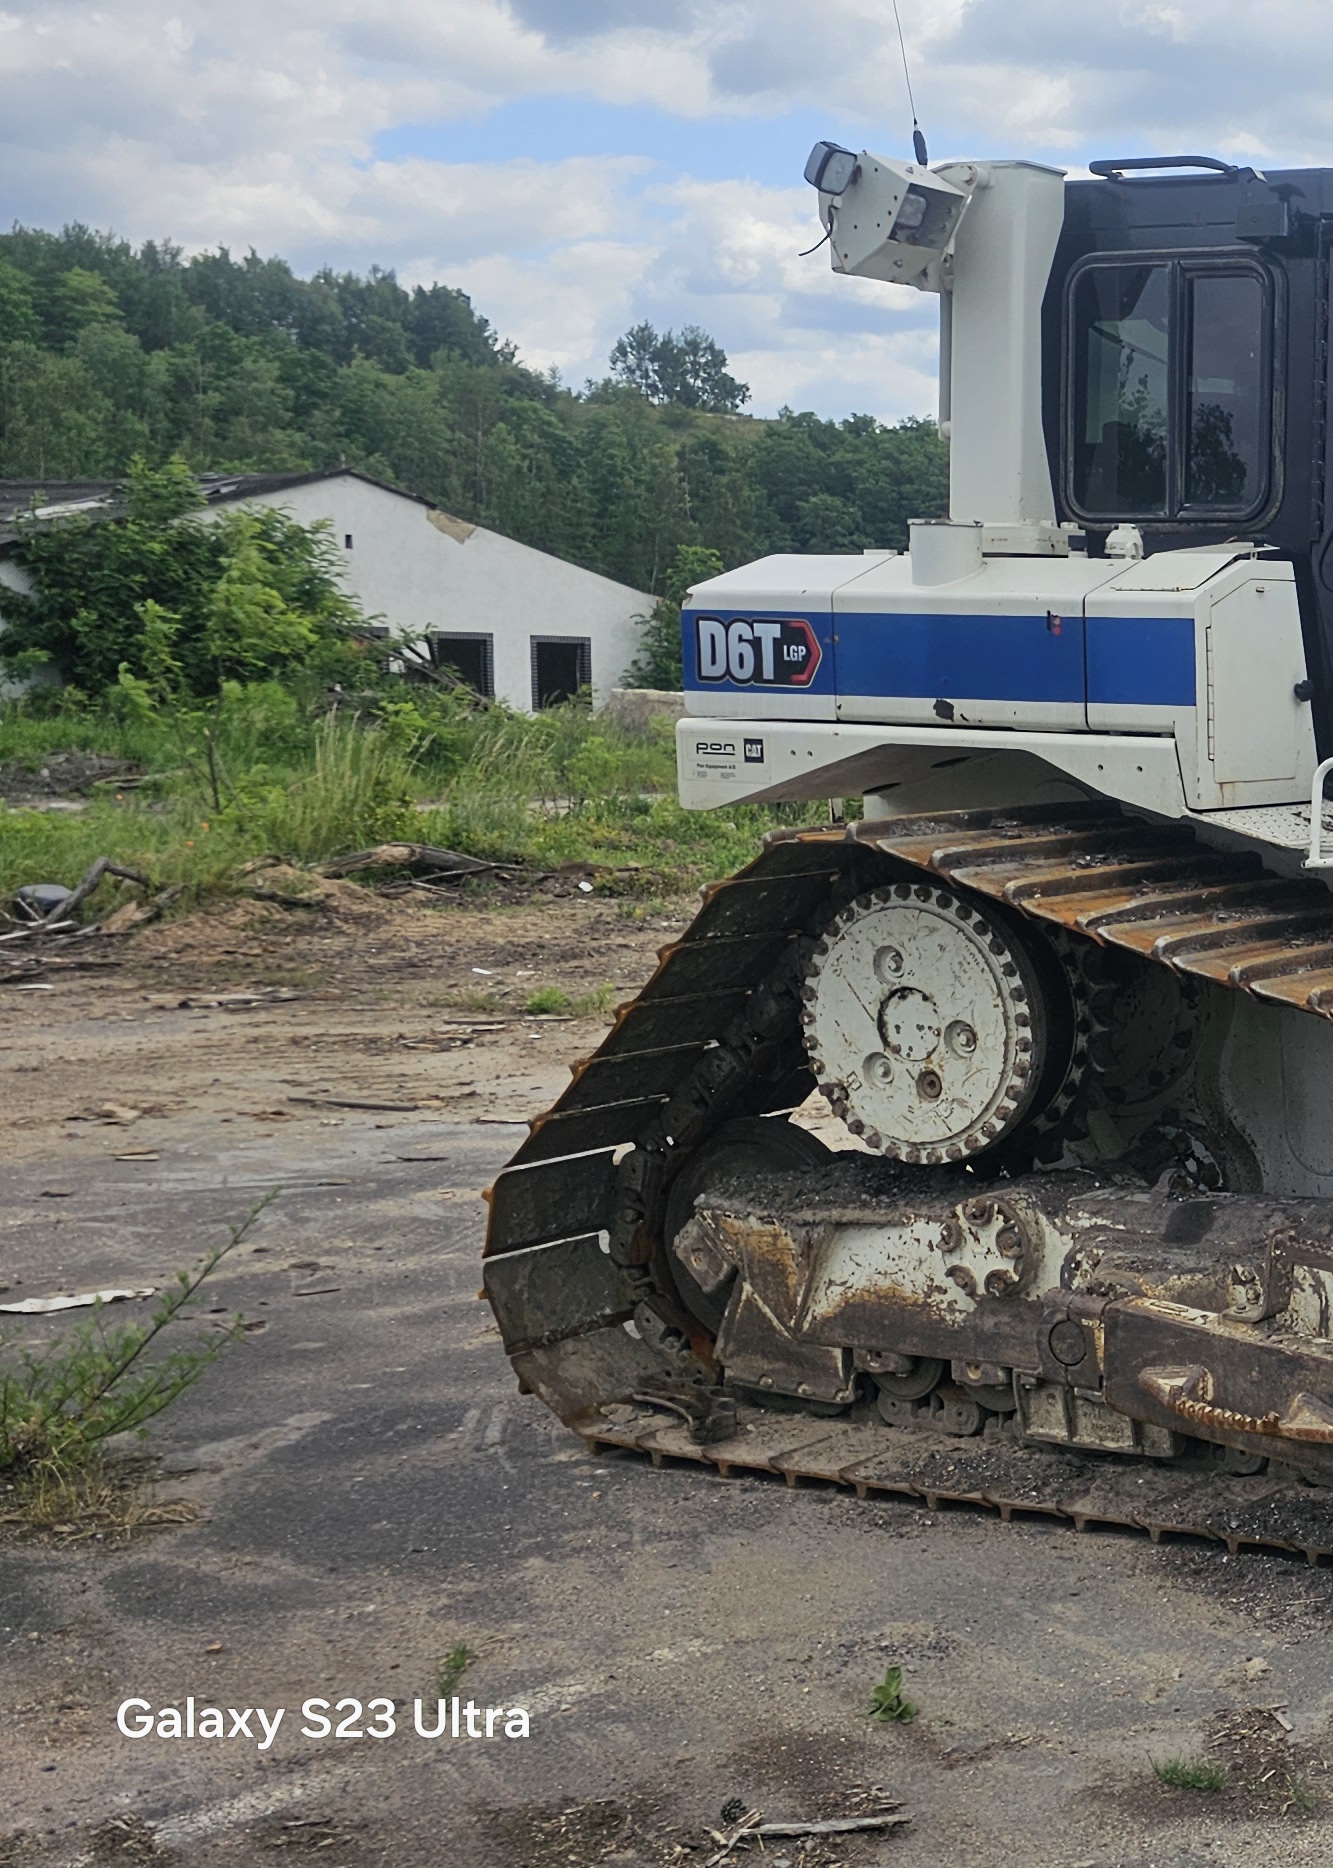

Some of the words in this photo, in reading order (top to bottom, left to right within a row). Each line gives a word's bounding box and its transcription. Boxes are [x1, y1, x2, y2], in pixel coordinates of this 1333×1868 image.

[698, 620, 781, 680] D6T
[783, 645, 806, 661] LGP
[696, 742, 736, 756] pon
[746, 744, 762, 757] CAT
